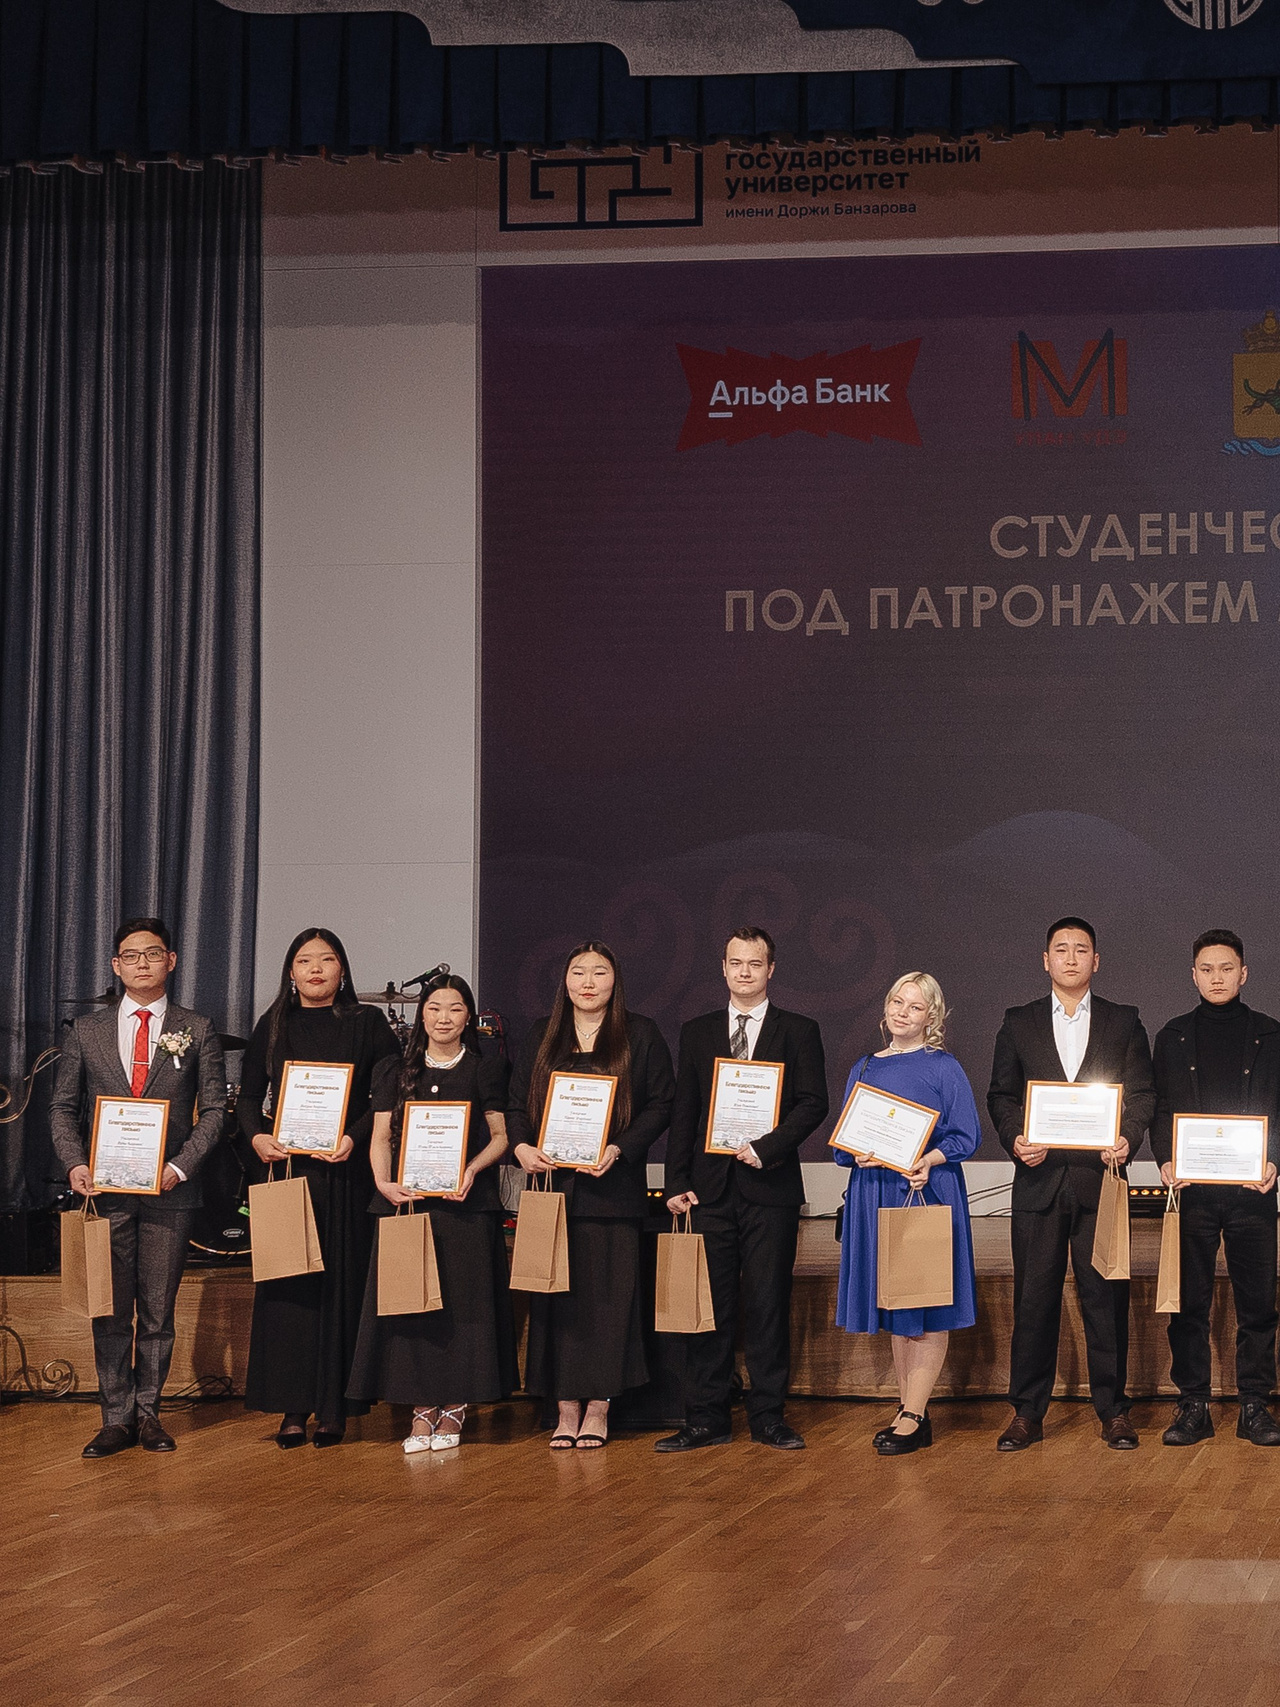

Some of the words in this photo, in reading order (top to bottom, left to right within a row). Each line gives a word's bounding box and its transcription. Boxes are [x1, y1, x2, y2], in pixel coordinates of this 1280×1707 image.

[724, 139, 982, 174] государственный
[724, 171, 911, 200] университет
[724, 207, 774, 219] имени
[777, 204, 830, 219] Доржи
[834, 201, 917, 216] Банзарова
[709, 379, 809, 413] Альфа
[815, 377, 892, 404] Банк
[723, 589, 850, 636] ПОД
[868, 577, 1259, 627] ПАТРОНАЖЕМ
